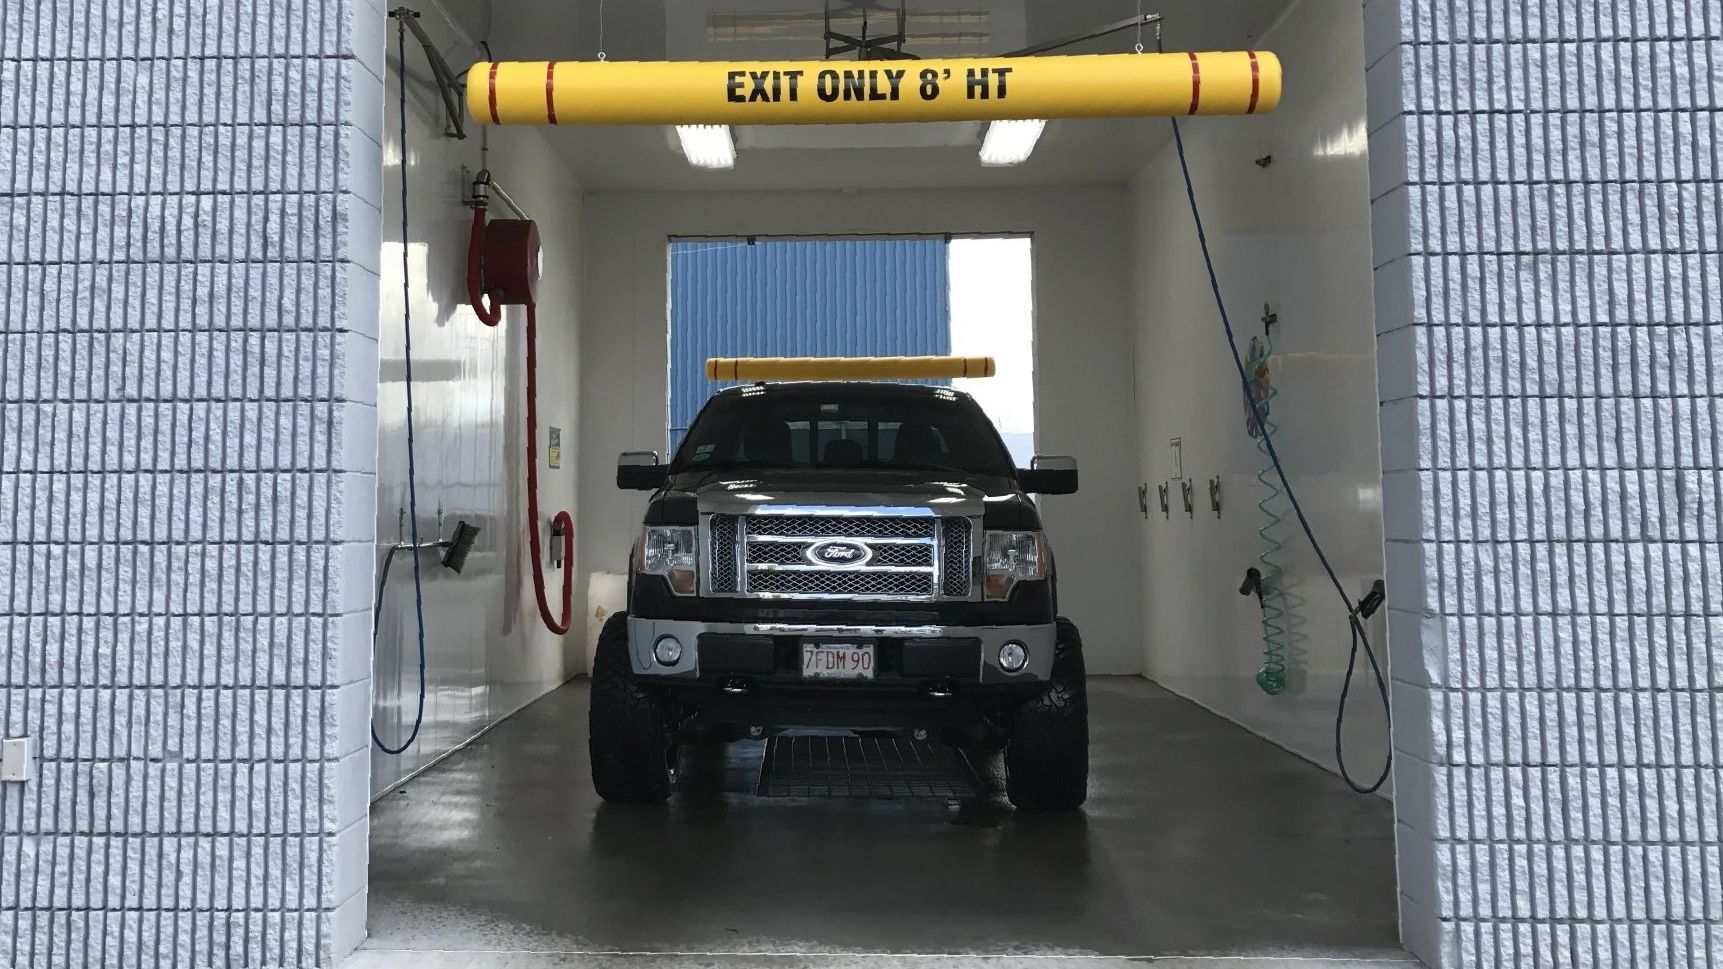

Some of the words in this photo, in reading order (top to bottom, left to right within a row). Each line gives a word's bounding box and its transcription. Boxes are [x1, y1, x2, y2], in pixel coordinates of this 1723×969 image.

[727, 70, 804, 103] EXIT
[817, 69, 906, 102] ONLY
[966, 67, 1013, 100] HT
[824, 545, 855, 559] Ford
[805, 650, 847, 670] 7FDM
[851, 651, 872, 670] 90
